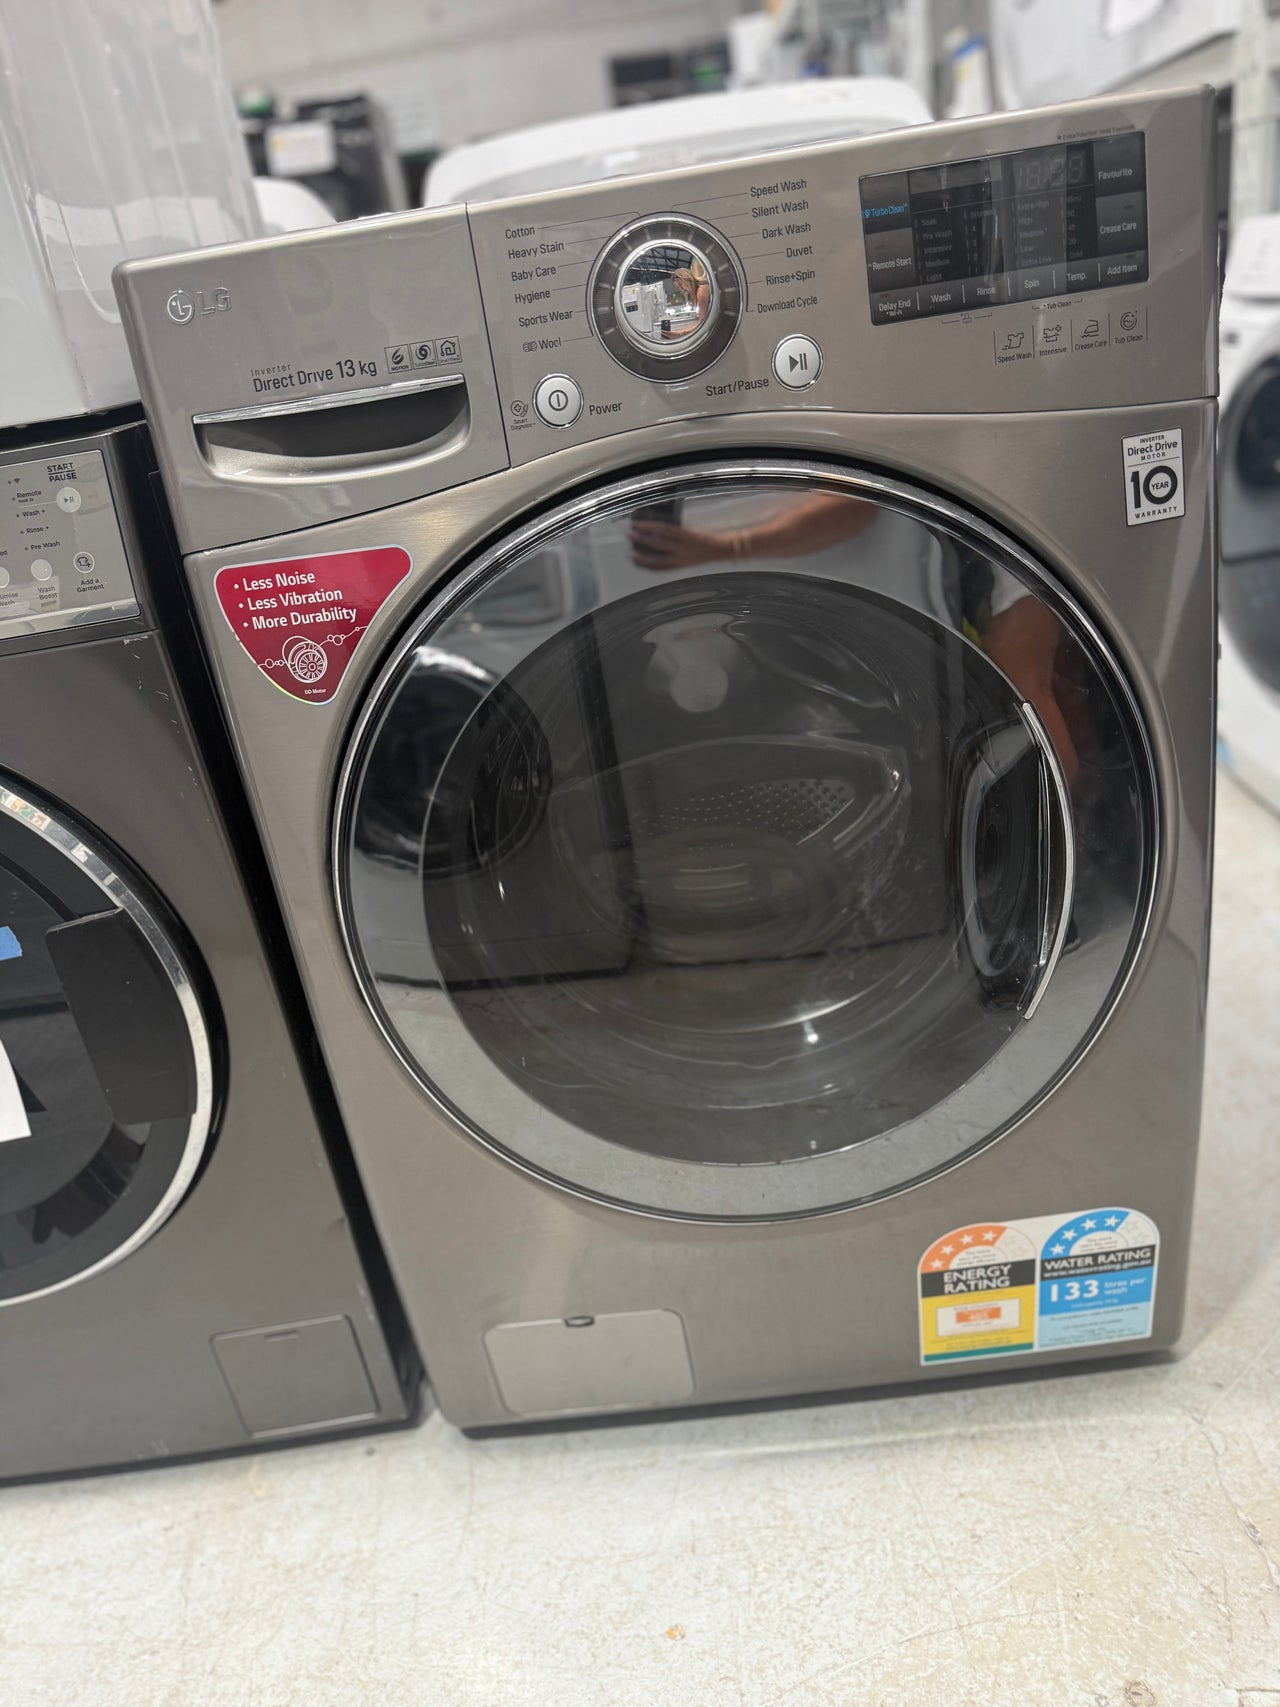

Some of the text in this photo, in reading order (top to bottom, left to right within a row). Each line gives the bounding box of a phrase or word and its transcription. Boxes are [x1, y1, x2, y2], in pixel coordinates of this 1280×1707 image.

[1098, 167, 1133, 180] Favourite
[750, 179, 807, 198] Speed Wash
[752, 200, 809, 218] Silent Wash
[505, 226, 535, 239] Cotton
[762, 222, 811, 239] Dark Wash
[1100, 222, 1137, 234] Crease Care
[508, 241, 564, 260] Heavy Stain
[786, 246, 813, 258] Duvet
[873, 258, 912, 270] Remote Start
[1107, 264, 1138, 275] Add Item
[511, 266, 556, 281] Baby Care
[766, 269, 816, 286] Rinse+Spin
[1024, 279, 1040, 290] Spin
[515, 290, 550, 304] Hygiene
[976, 287, 996, 296] Rinse
[196, 287, 231, 316] LG
[757, 296, 818, 314] Download Cycle
[931, 293, 952, 304] Wash
[879, 299, 911, 312] Delay End
[518, 310, 574, 328] Sports Wear
[539, 336, 562, 350] Wool
[1075, 340, 1107, 351] Crease Care
[1114, 334, 1143, 344] Tub Clean
[998, 352, 1032, 364] Speed Wash
[1040, 347, 1067, 356] Intensive
[250, 364, 291, 377] Inverter
[253, 359, 378, 392] Direct Drive 13 kg
[706, 379, 769, 397] Start/Pause
[589, 402, 622, 416] Power
[1140, 435, 1165, 444] INVERTER
[1128, 441, 1178, 456] Direct Drive
[1141, 452, 1166, 460] MOTOR
[47, 462, 74, 472] START
[49, 472, 77, 482] PAUSE
[1130, 465, 1178, 509] 10
[1152, 481, 1170, 490] YEAR
[17, 490, 42, 498] Remote
[1135, 506, 1178, 518] WARRANTY
[243, 572, 316, 591] Less Noise
[76, 584, 104, 593] Garment
[39, 592, 58, 600] Boost
[248, 589, 343, 610] Less Vibration
[252, 607, 357, 630] More Durability
[1044, 1256, 1094, 1270] WATER
[1097, 1248, 1151, 1264] RATING
[943, 1264, 1012, 1283] ENERGY
[1043, 1260, 1152, 1278] www.waterrating.gov.au
[944, 1276, 1010, 1294] RATING
[1050, 1279, 1099, 1303] 133
